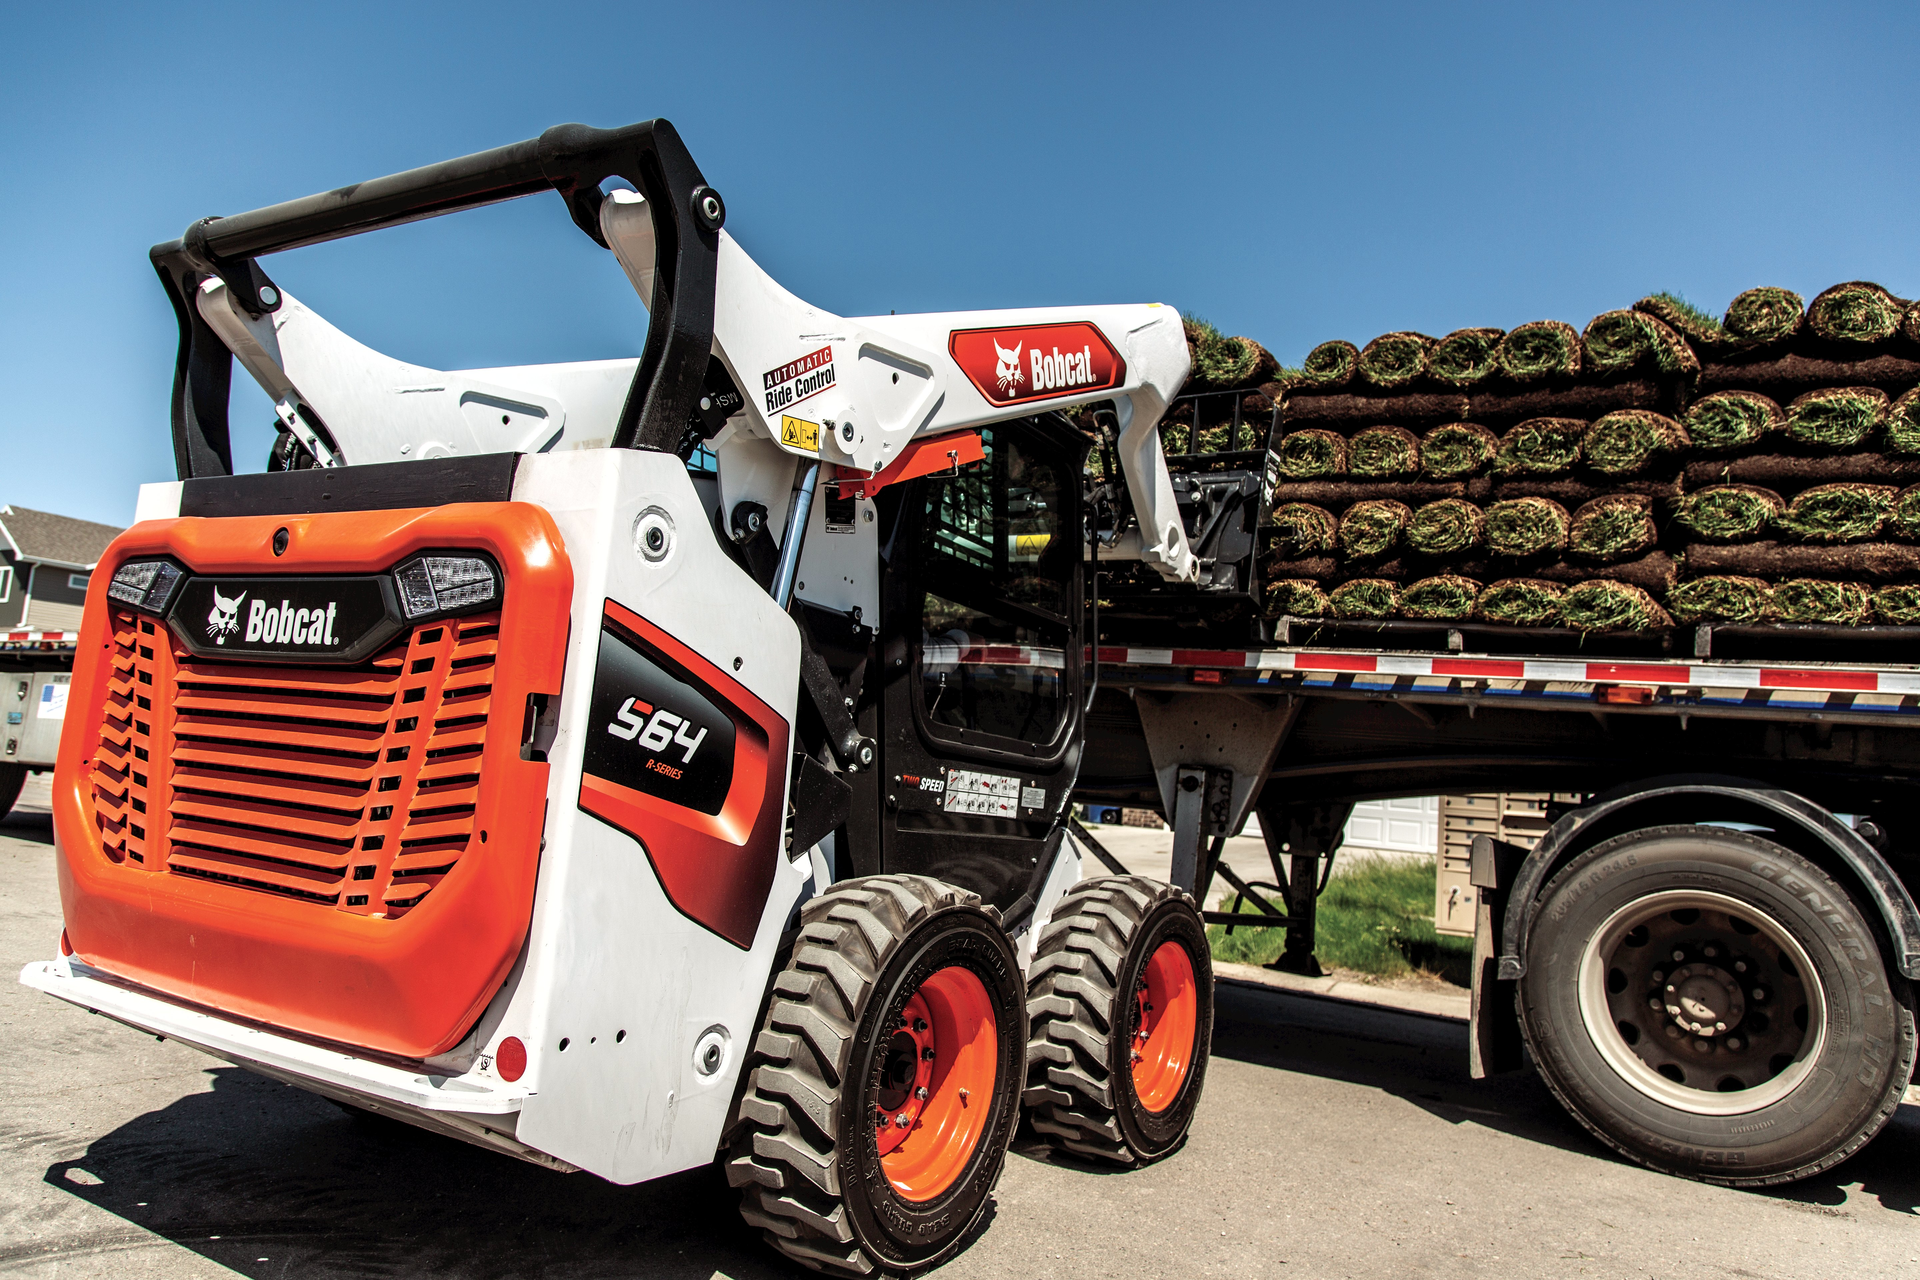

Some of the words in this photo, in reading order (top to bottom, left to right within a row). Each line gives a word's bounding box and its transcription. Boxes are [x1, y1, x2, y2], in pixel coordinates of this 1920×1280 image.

[765, 386, 793, 412] Ride
[795, 363, 836, 398] Control
[766, 349, 831, 388] AUTOMATIC
[1029, 345, 1093, 391] Bobcat
[245, 599, 336, 645] Bobcat
[607, 697, 708, 764] S64
[646, 759, 683, 780] R-SERIES
[902, 774, 920, 788] TWO
[920, 777, 945, 793] SPEED
[1751, 861, 1883, 1014] GENERAL
